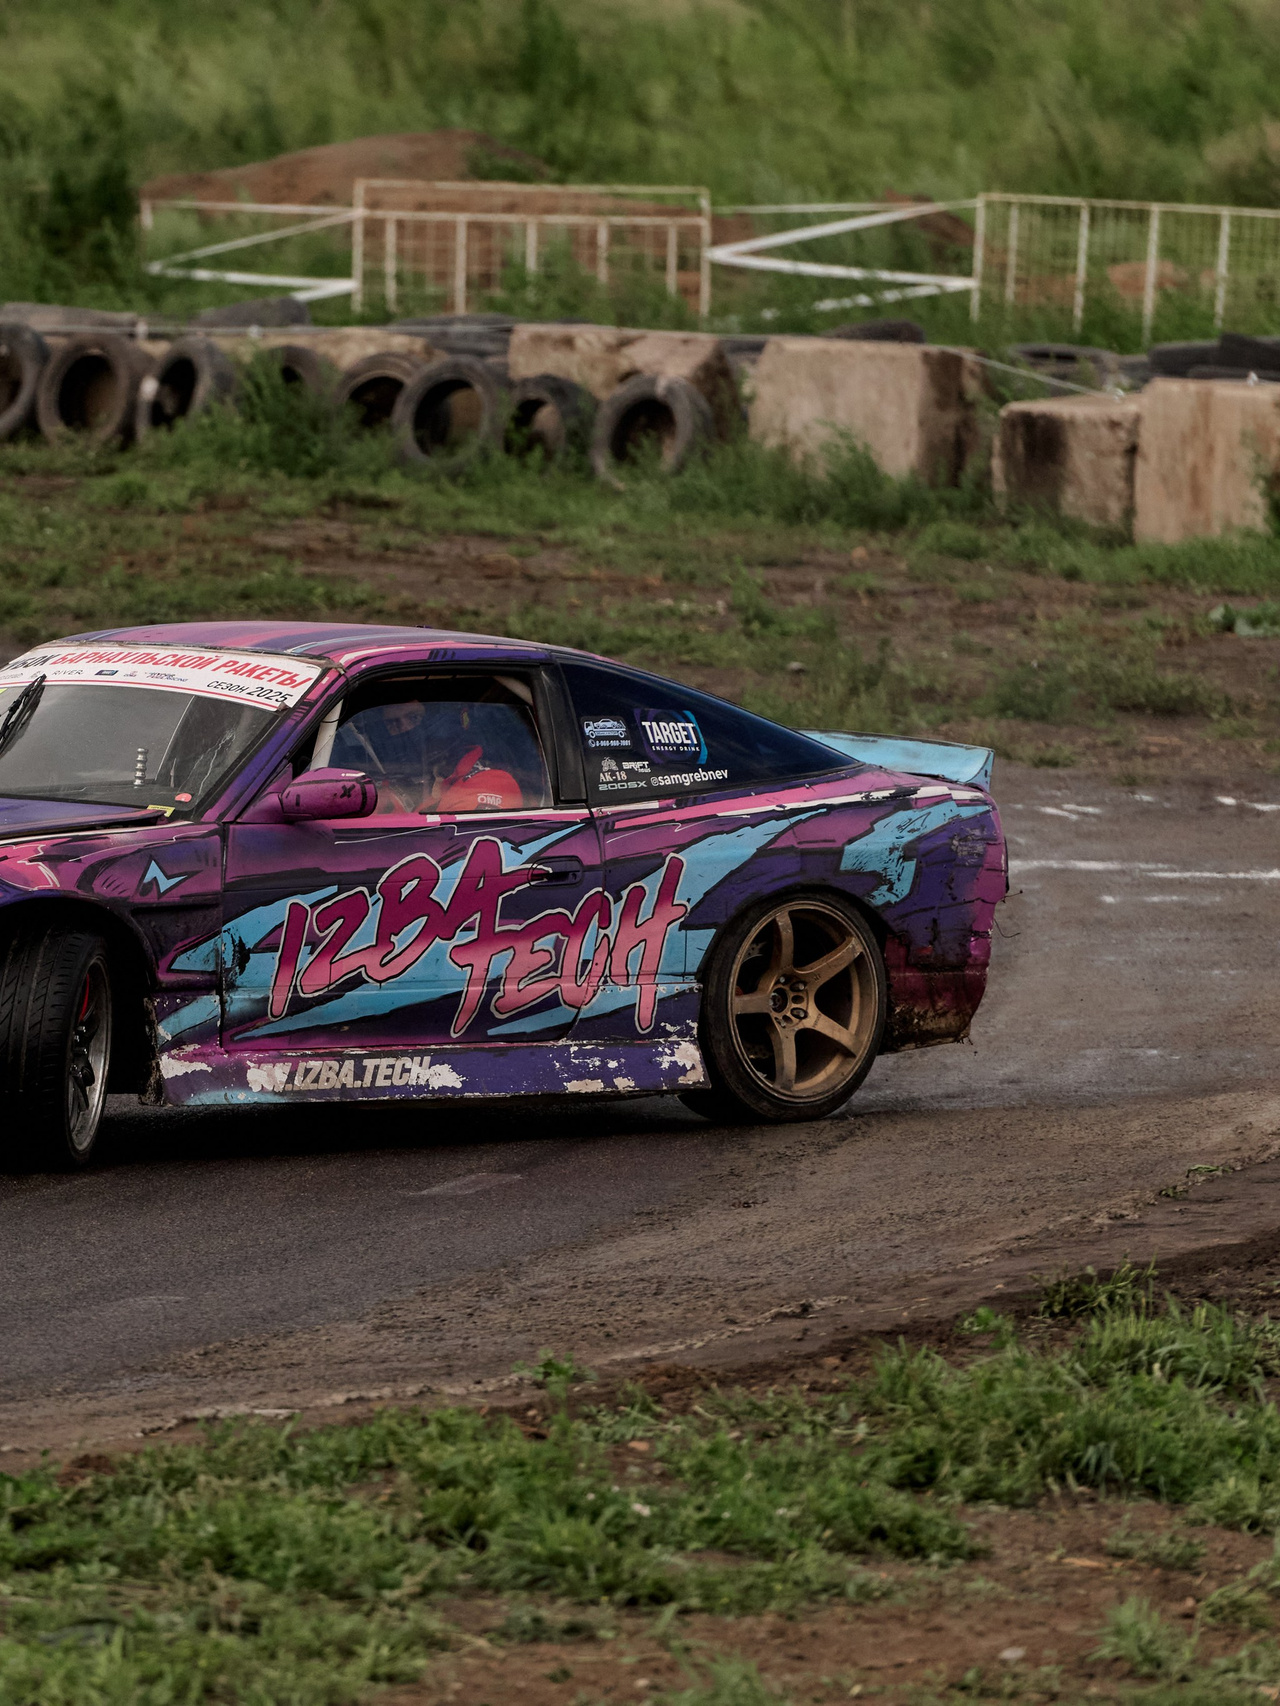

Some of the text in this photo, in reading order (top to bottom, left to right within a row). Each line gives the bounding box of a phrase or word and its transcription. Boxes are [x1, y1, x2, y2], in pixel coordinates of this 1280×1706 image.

[50, 651, 223, 670] БАРНАУЛЬСКОЙ
[211, 659, 314, 689] РАКЕТЫ
[206, 680, 293, 703] СЕЗОН 2025
[641, 720, 698, 745] TARGET
[598, 780, 648, 791] 200SX
[650, 768, 729, 787] @samgrebnev
[477, 793, 503, 806] OMP
[267, 836, 552, 1023] IZBA
[448, 852, 688, 1039] TECH
